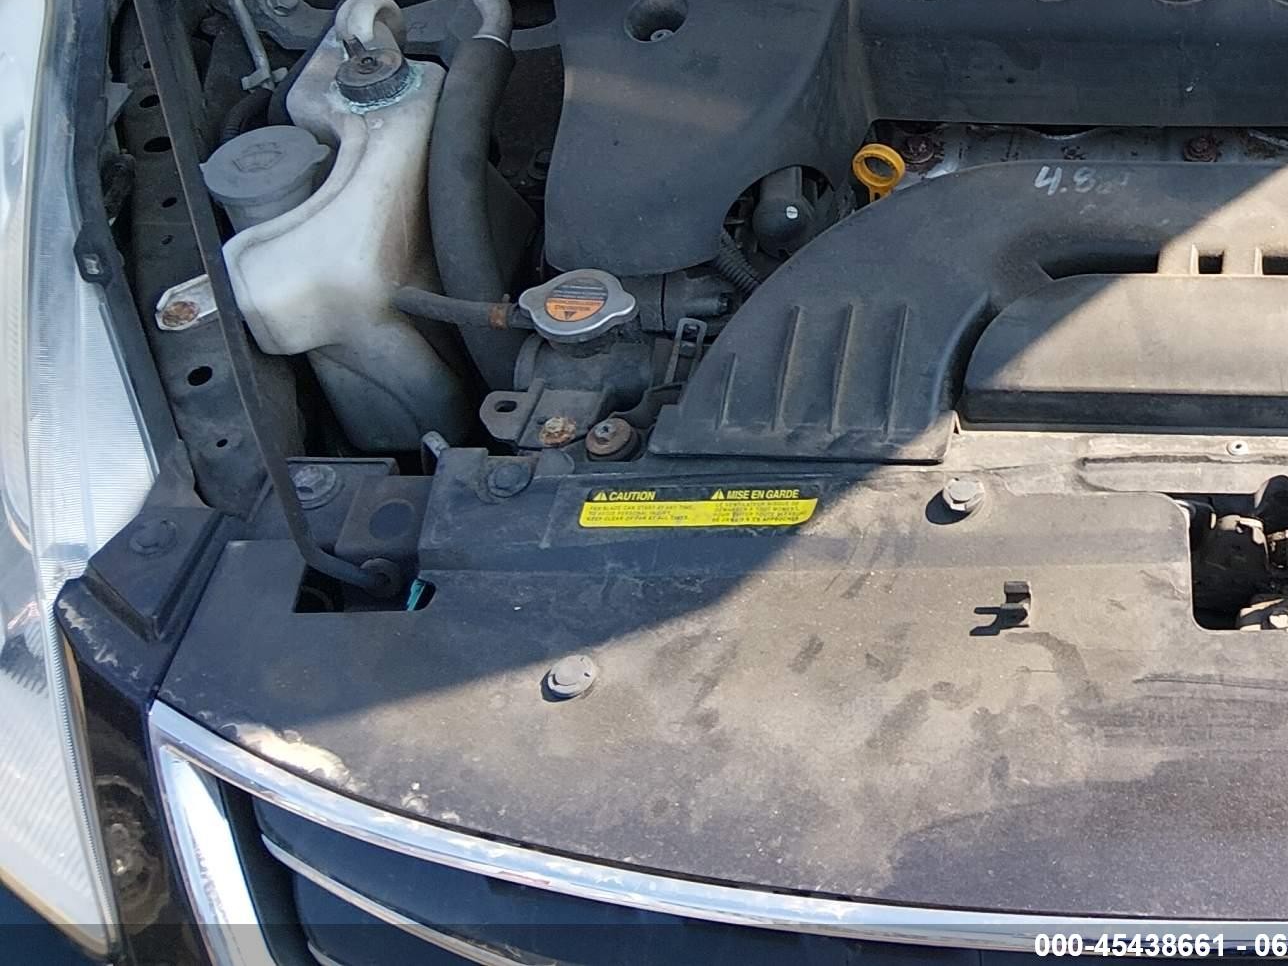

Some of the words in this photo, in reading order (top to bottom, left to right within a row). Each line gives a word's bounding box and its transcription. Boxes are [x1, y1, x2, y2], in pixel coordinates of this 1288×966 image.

[609, 491, 657, 501] CAUTION
[726, 490, 750, 500] MISE
[751, 490, 765, 500] EN
[766, 489, 800, 499] GARDE
